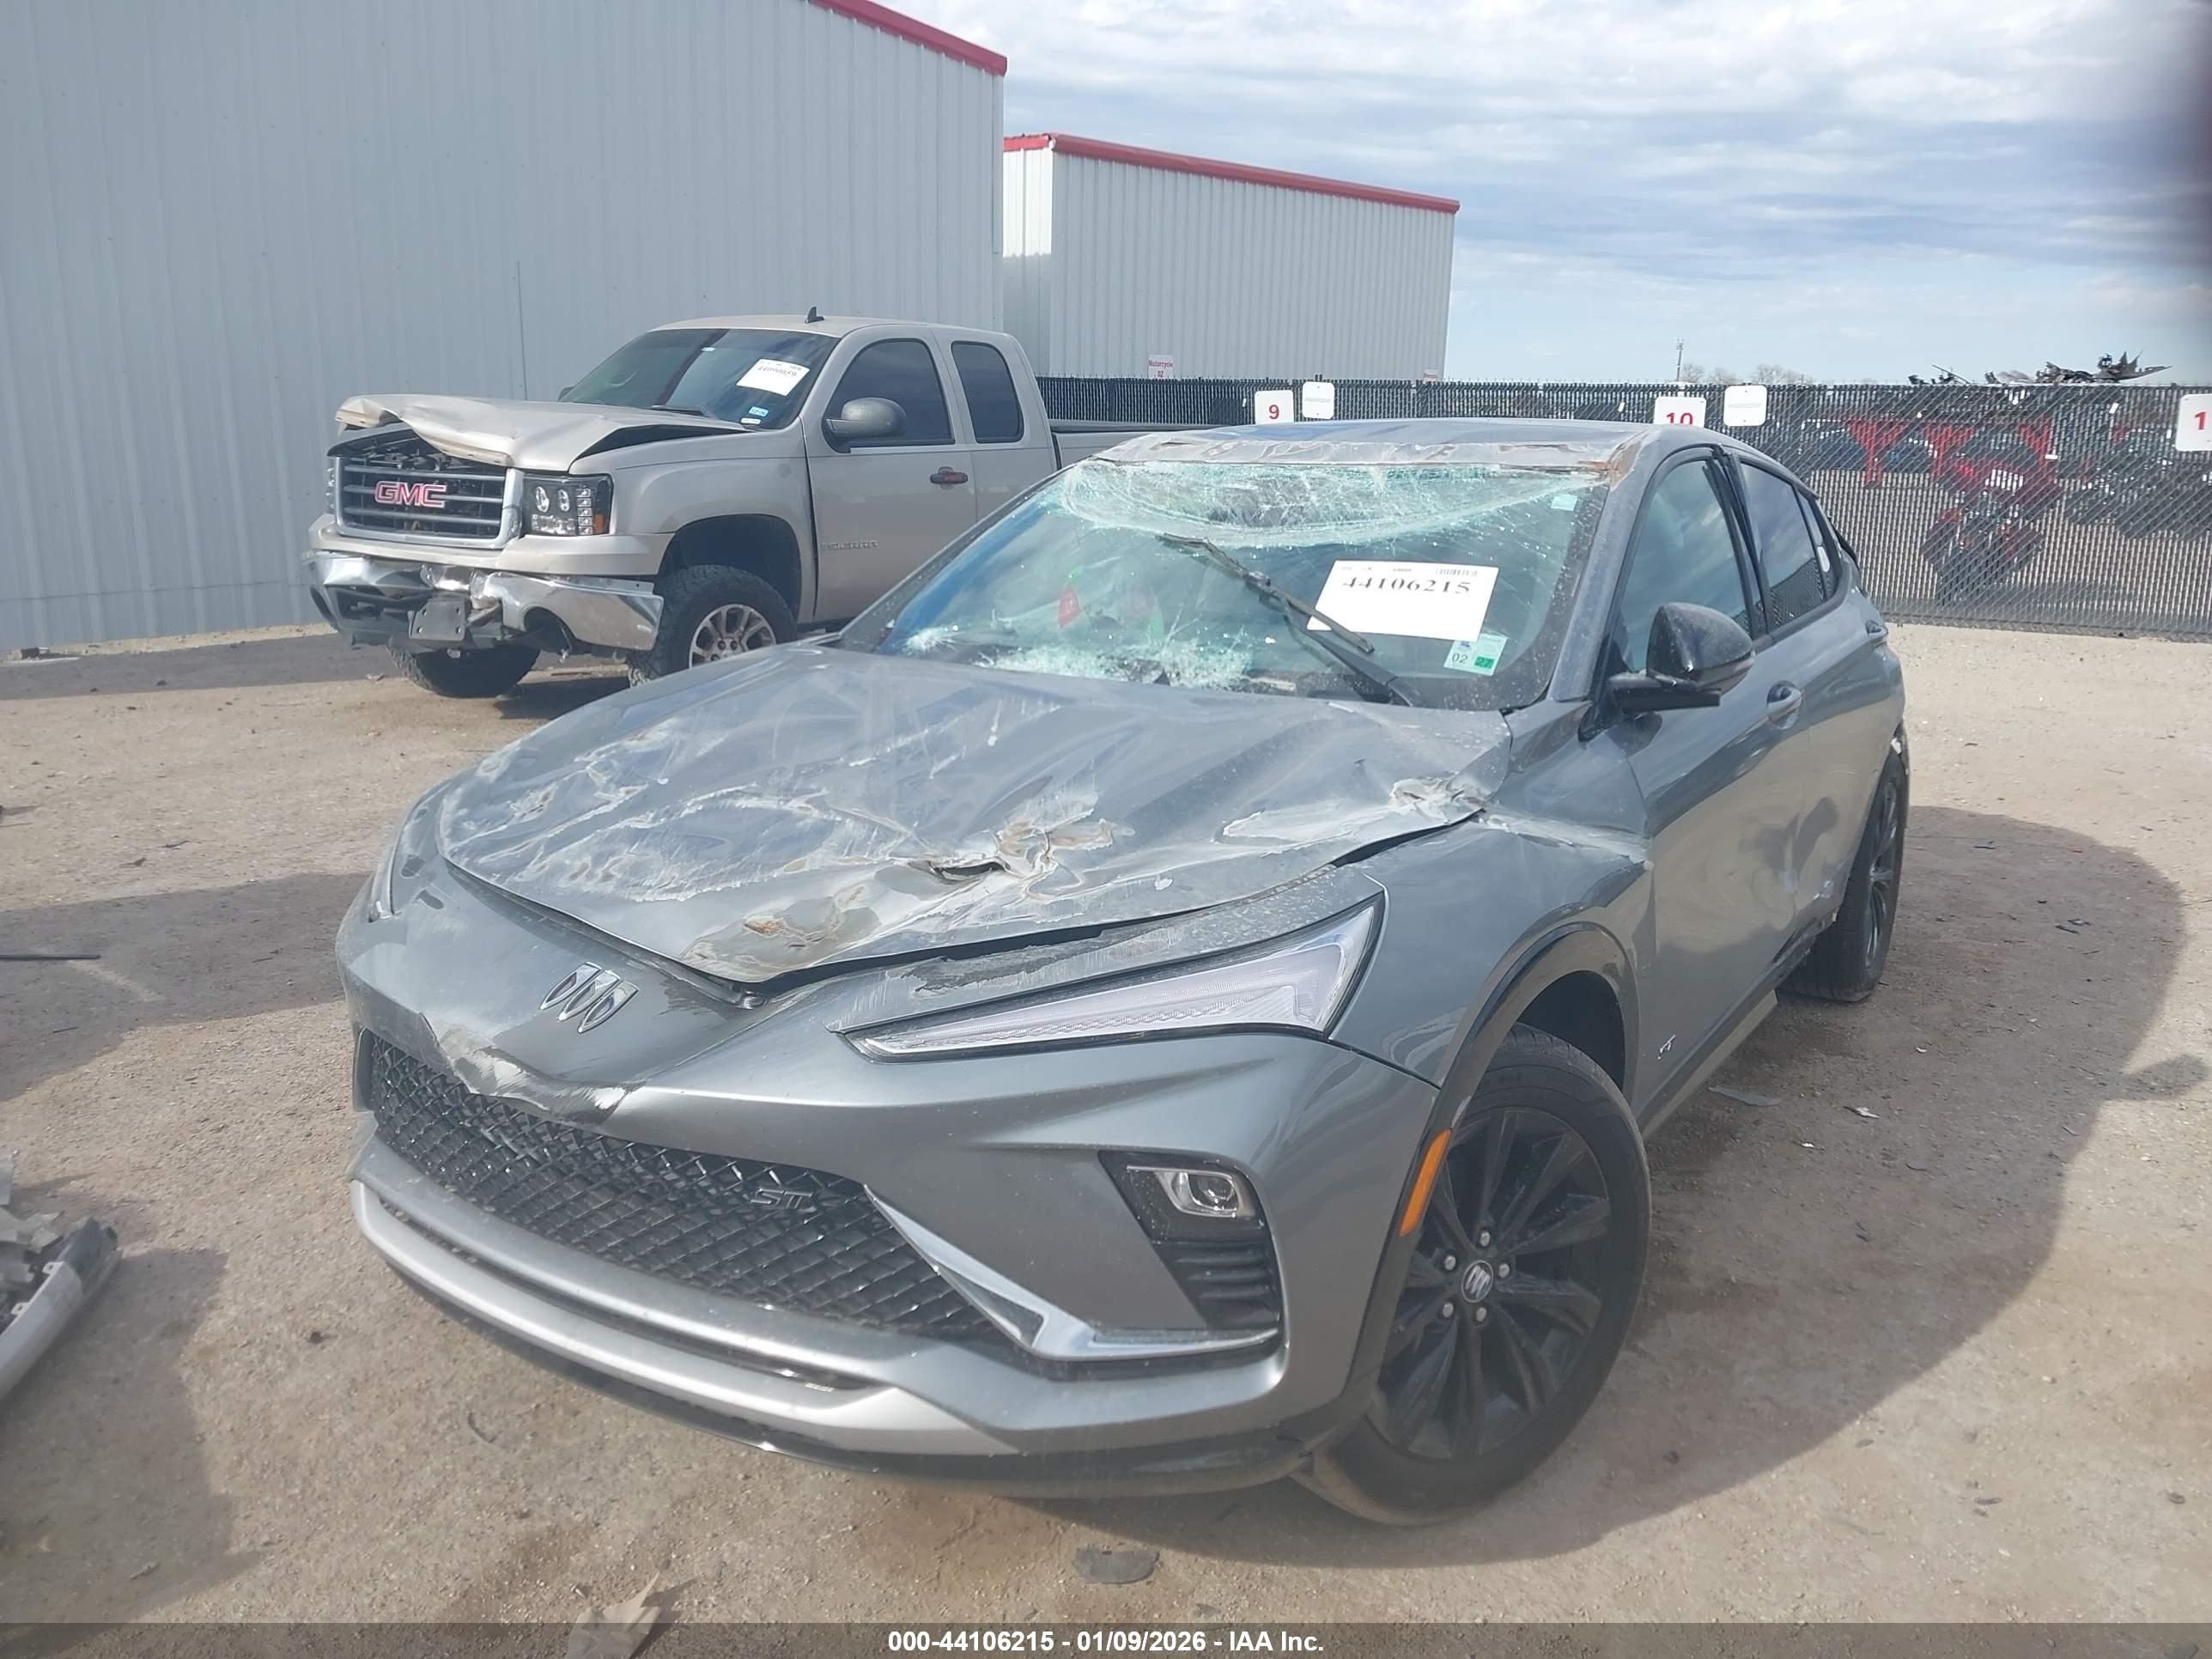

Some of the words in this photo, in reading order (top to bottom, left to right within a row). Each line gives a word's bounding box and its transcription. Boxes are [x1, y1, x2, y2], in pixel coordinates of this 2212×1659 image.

[1268, 404, 1279, 420] 9
[1666, 412, 1694, 425] 10
[374, 480, 447, 508] GMC
[1342, 576, 1471, 594] 44106215
[1452, 653, 1468, 664] 02
[1477, 657, 1492, 668] 27
